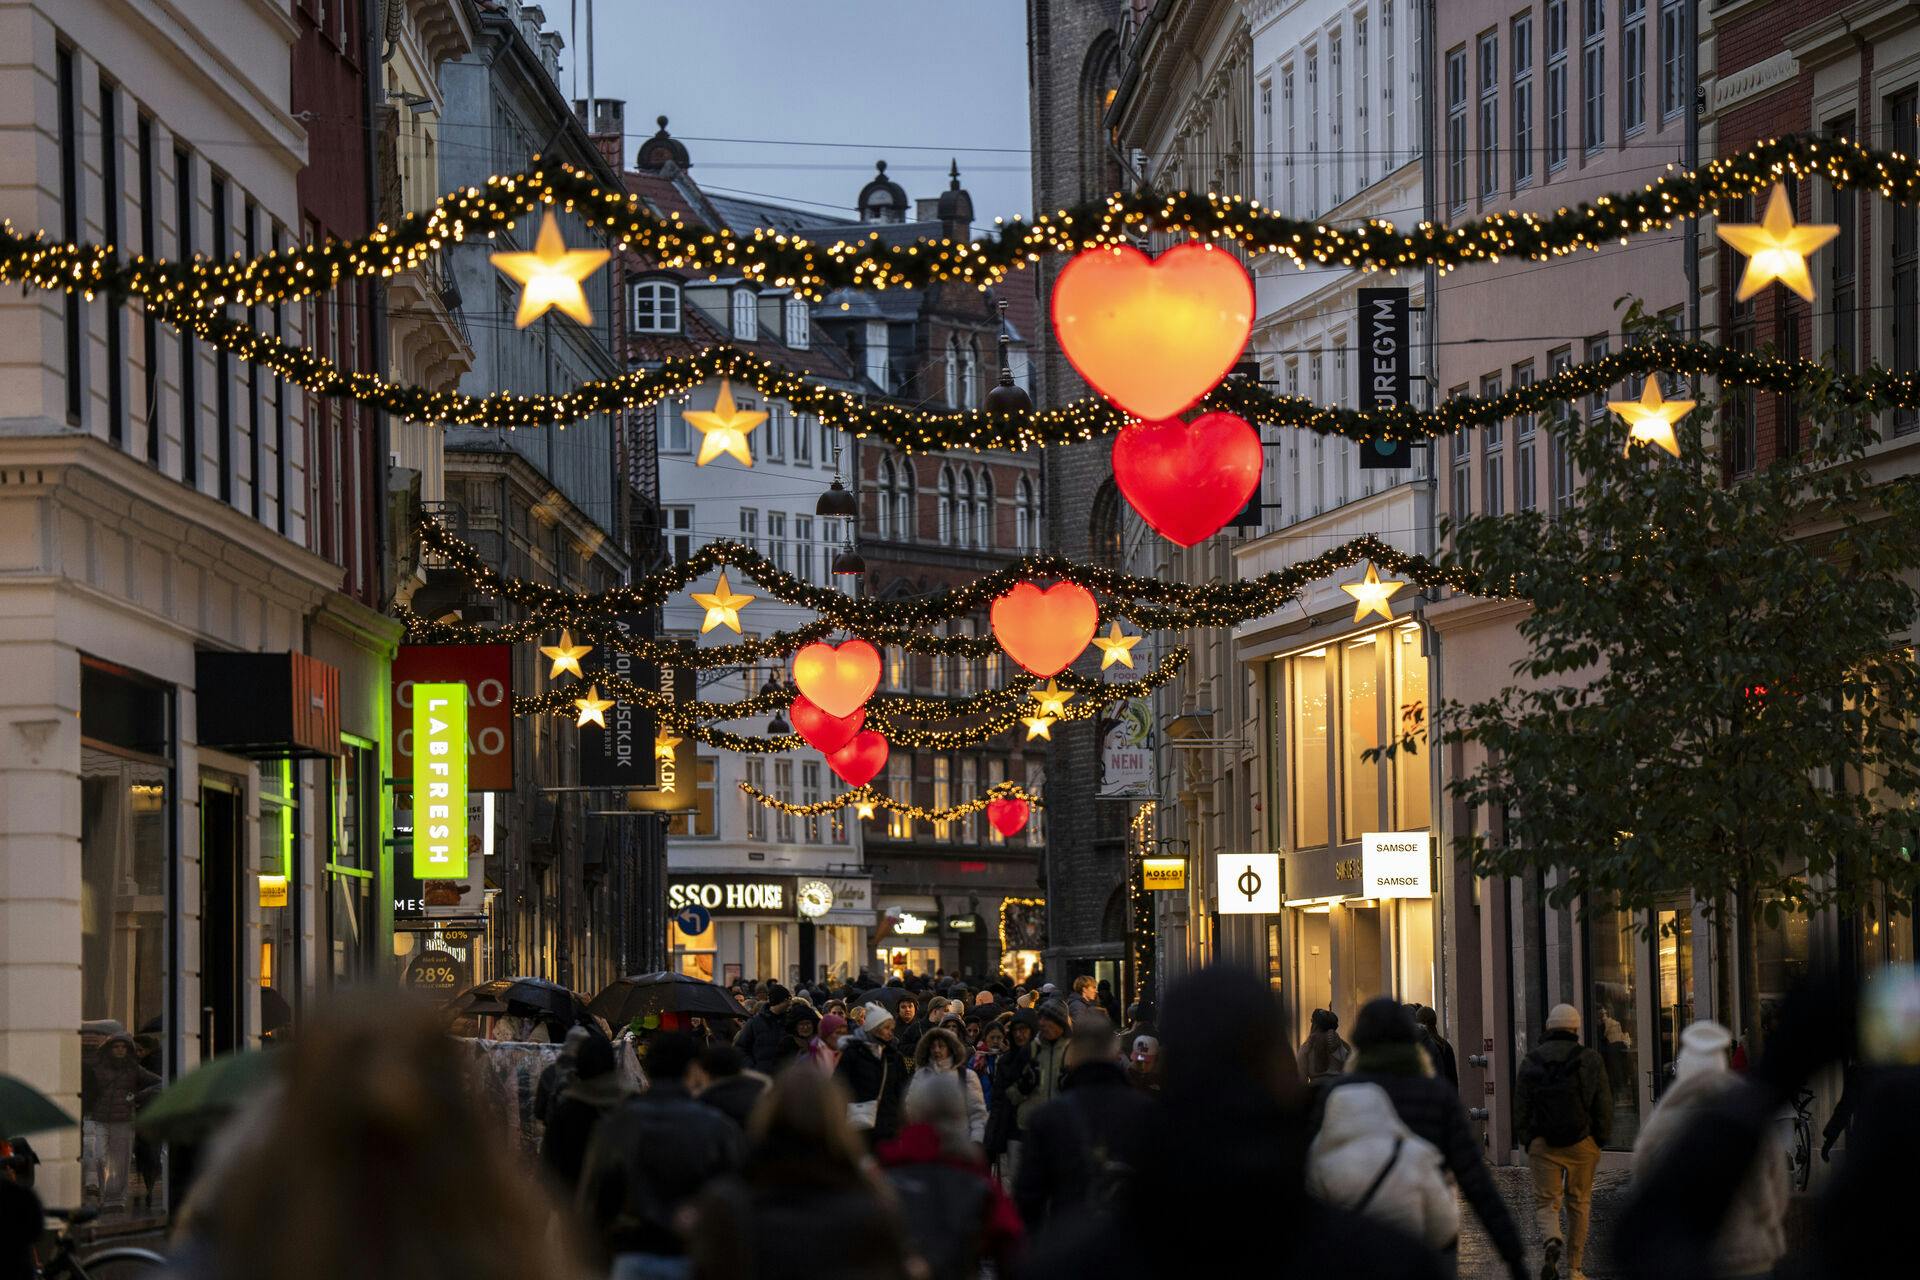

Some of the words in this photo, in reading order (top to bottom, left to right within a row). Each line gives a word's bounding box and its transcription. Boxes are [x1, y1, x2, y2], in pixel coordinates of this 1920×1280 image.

[1373, 299, 1397, 410] UREGYM
[1111, 754, 1143, 769] NENI
[428, 698, 449, 864] LABFRESH
[668, 884, 723, 909] SSO
[726, 884, 783, 909] HOUSE
[445, 930, 468, 940] 60%
[415, 967, 455, 983] 28%
